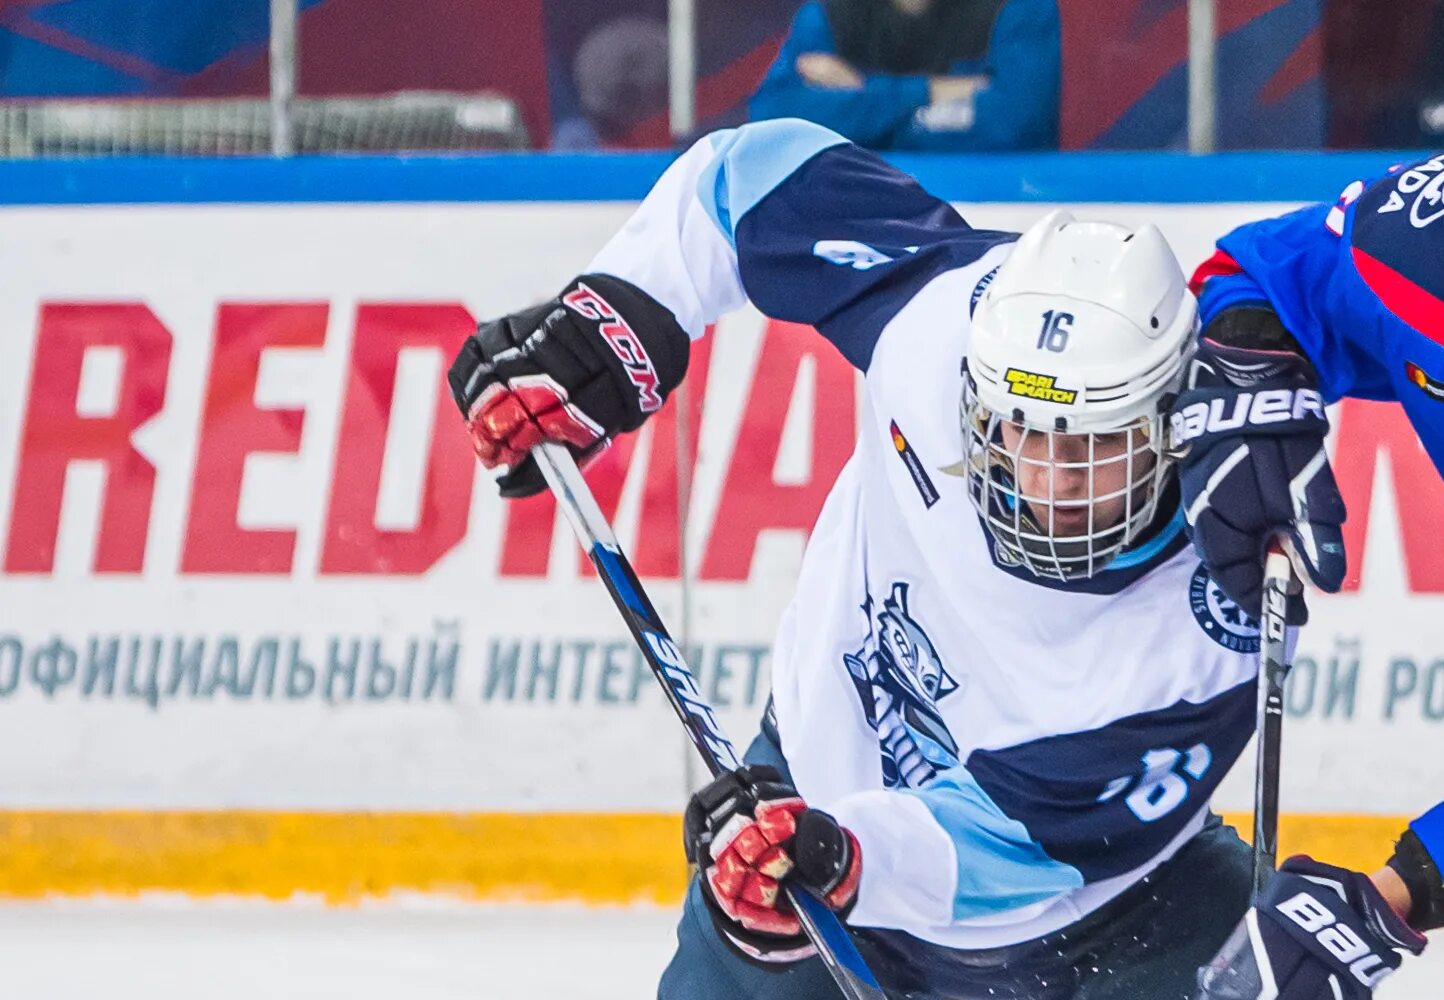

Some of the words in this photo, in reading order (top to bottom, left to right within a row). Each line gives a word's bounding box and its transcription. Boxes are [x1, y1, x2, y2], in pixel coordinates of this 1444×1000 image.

[563, 281, 663, 413] CCM
[1037, 309, 1075, 353] 16
[480, 632, 770, 708] ИНТЕРЕТ
